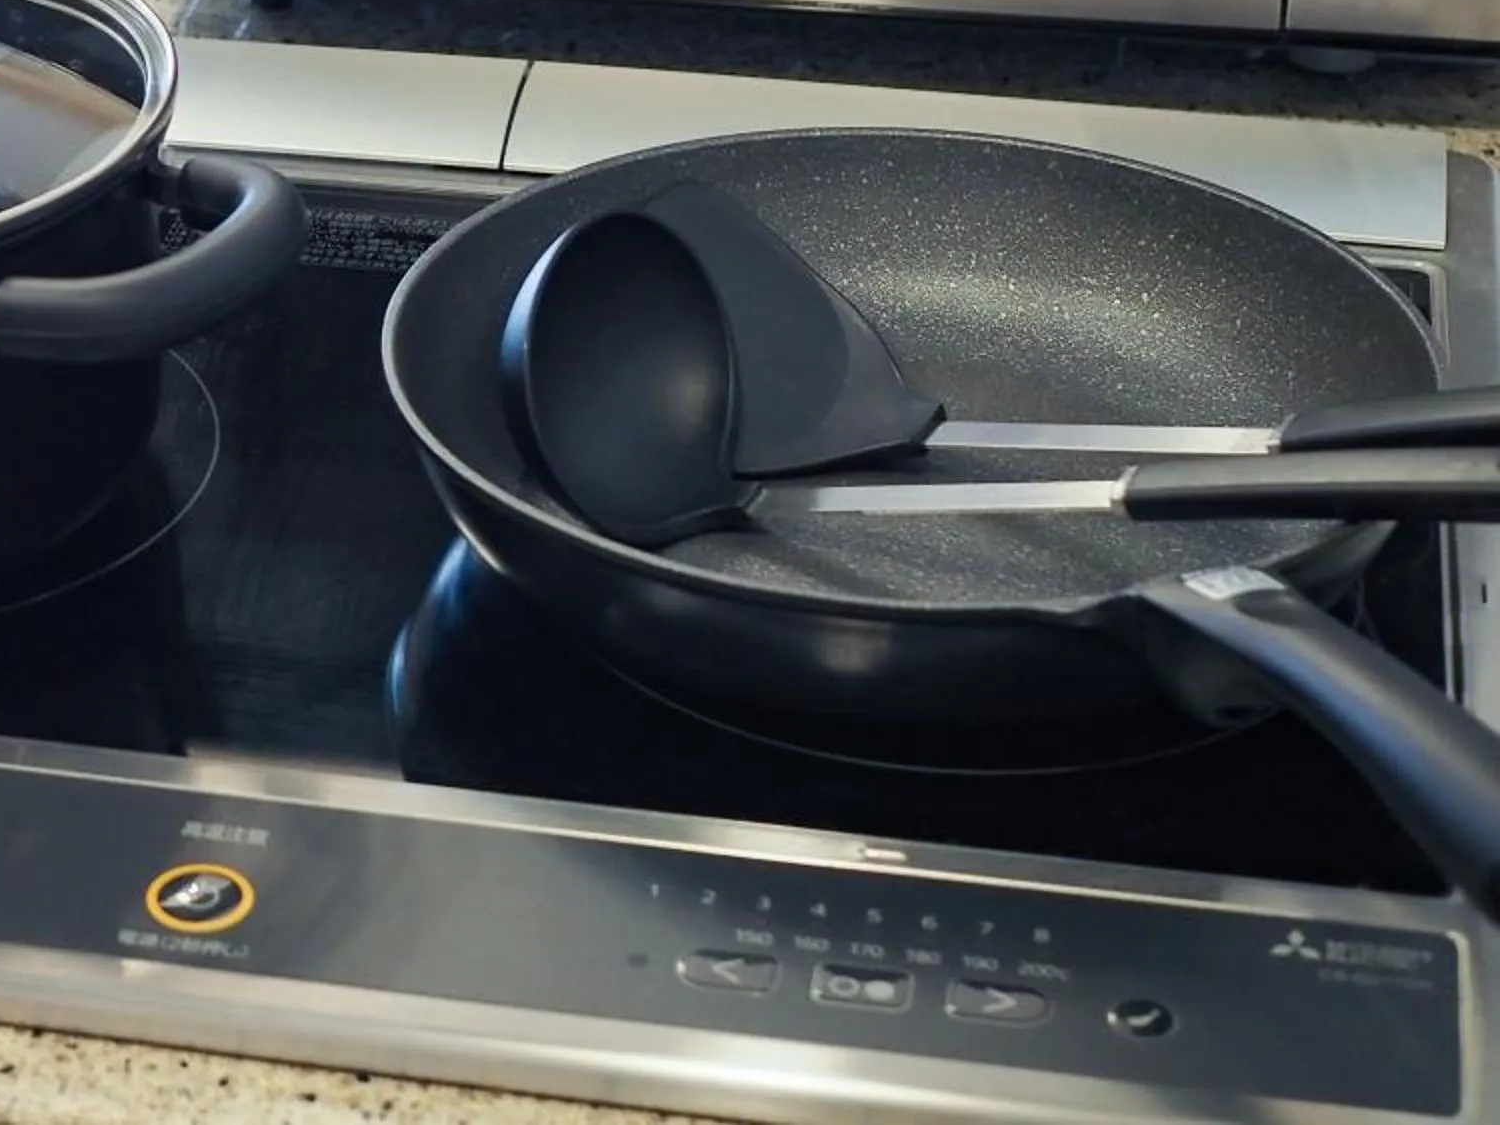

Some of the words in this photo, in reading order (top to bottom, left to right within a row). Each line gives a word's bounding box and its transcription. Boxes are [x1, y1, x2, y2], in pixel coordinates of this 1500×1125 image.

[649, 883, 660, 898] 1
[701, 889, 717, 905] 2
[757, 895, 772, 911] 3
[809, 902, 828, 918] 4
[866, 907, 883, 924] 5
[920, 915, 939, 931] 6
[980, 920, 995, 936] 7
